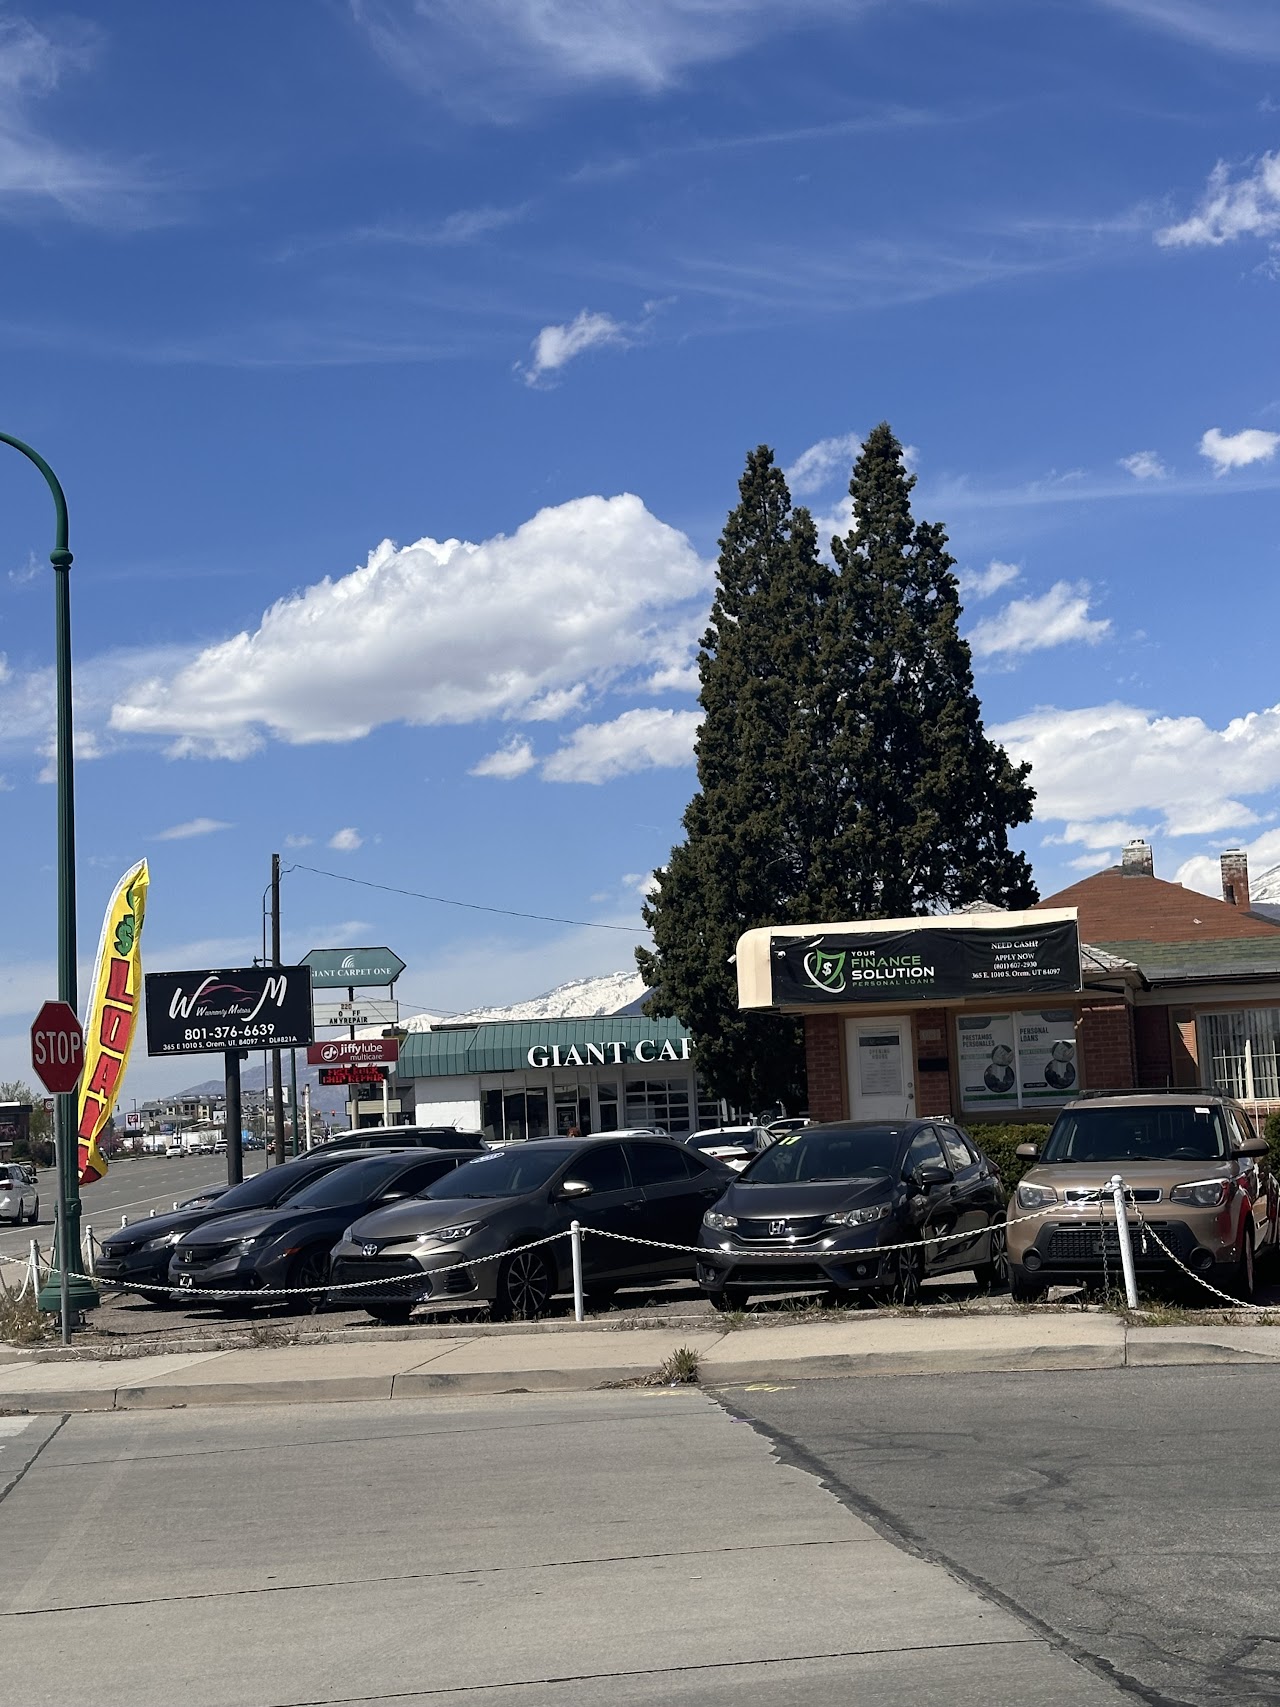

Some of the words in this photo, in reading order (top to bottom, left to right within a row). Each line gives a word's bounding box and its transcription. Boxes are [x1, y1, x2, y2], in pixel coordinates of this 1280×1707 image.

[991, 942, 1013, 950] NEED
[851, 955, 921, 969] FINANCE
[337, 968, 371, 977] CARPET
[373, 967, 392, 975] ONE
[851, 966, 935, 981] SOLUTION
[990, 970, 1005, 978] 1010
[196, 1005, 228, 1018] Warranty
[227, 1003, 252, 1015] Motors
[184, 1023, 275, 1041] 801-376-6639
[1020, 1027, 1049, 1035] PERSONAL
[34, 1030, 81, 1065] STOP
[163, 1043, 175, 1051] 365
[238, 1038, 259, 1046] 84097
[269, 1036, 298, 1044] DL#821A
[350, 1053, 384, 1061] multicare
[527, 1041, 627, 1068] GIANT
